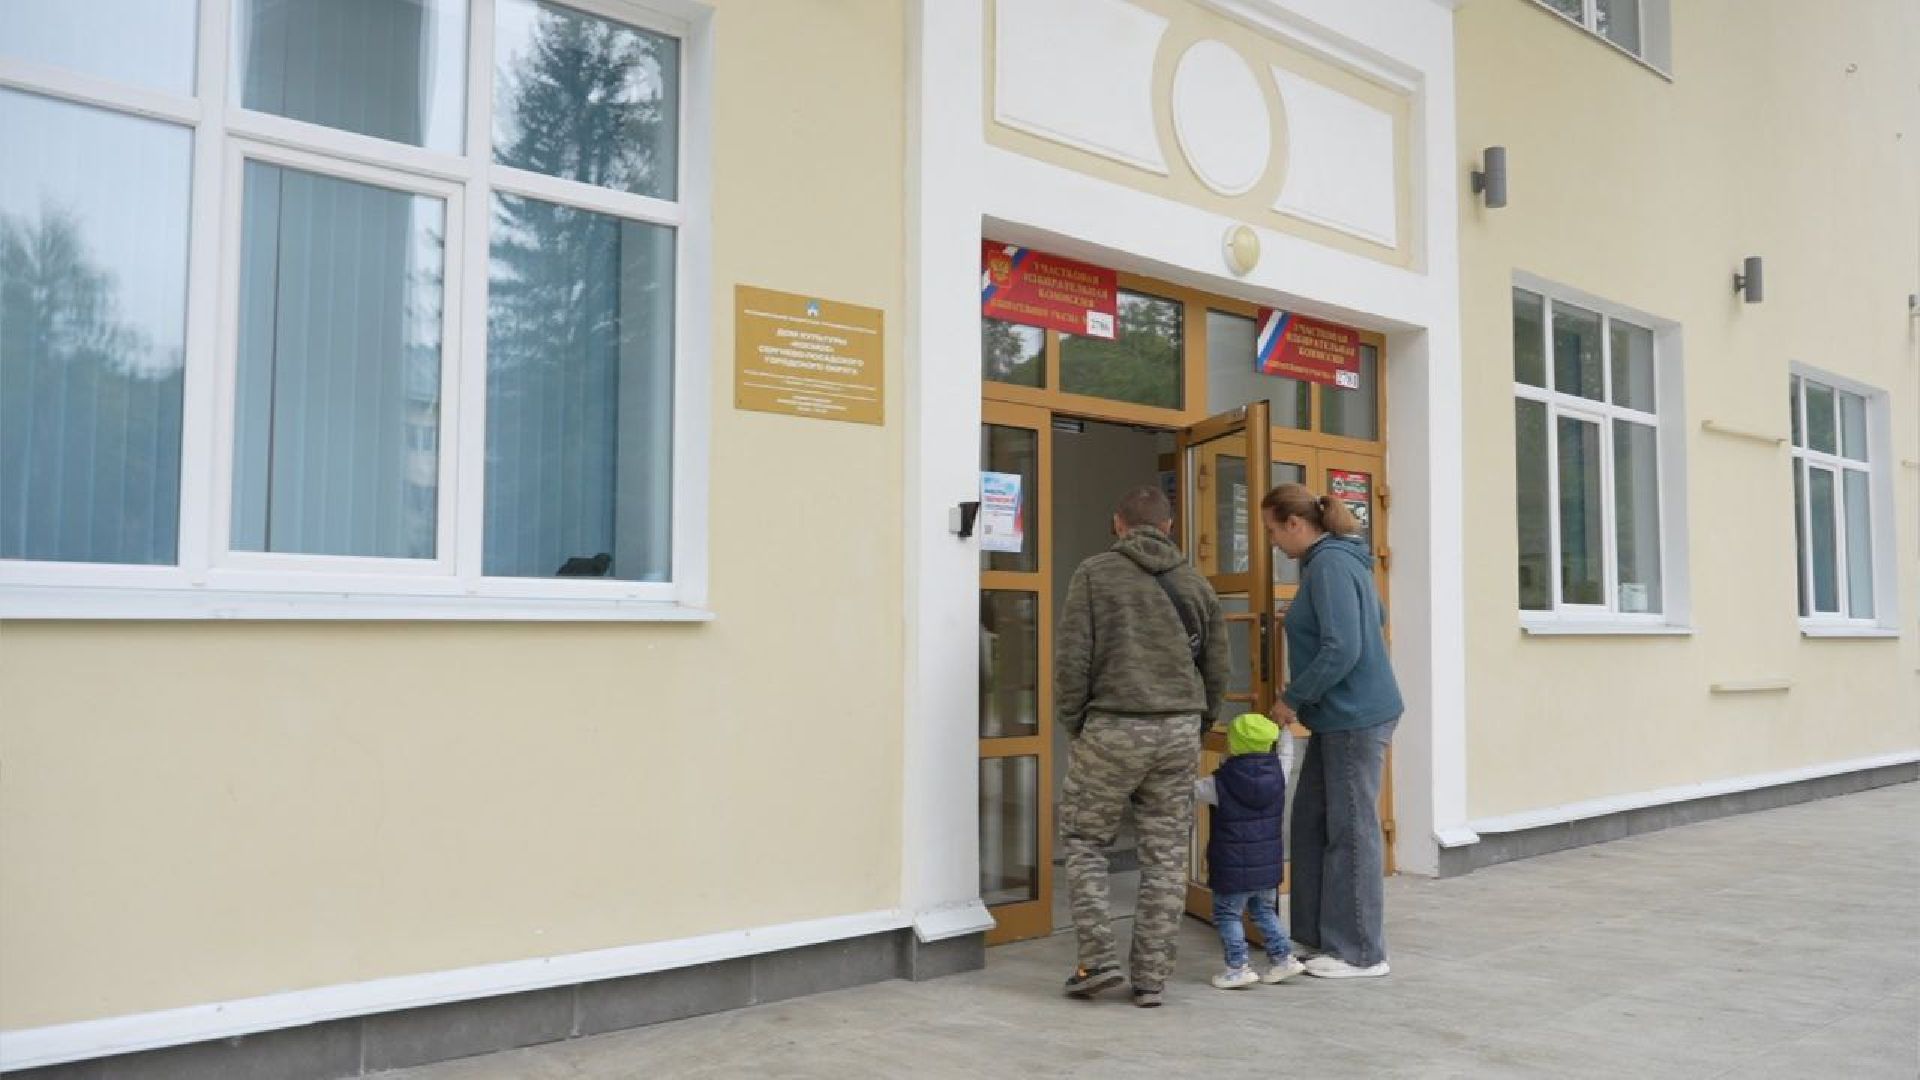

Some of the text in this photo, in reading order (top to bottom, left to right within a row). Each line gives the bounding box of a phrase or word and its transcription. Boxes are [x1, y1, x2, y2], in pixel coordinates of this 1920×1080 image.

[1033, 262, 1100, 285] УЧАСТКОВАЯ
[1022, 273, 1108, 300] ИЗБИРАТЕЛЬНАЯ
[1038, 288, 1095, 307] КОМИССИЯ
[1287, 332, 1355, 357] ИЗБИРАТЕЛЬНАЯ
[1295, 323, 1348, 344] УЧАСТКОВАЯ
[1299, 346, 1345, 365] КОМИССИЯ
